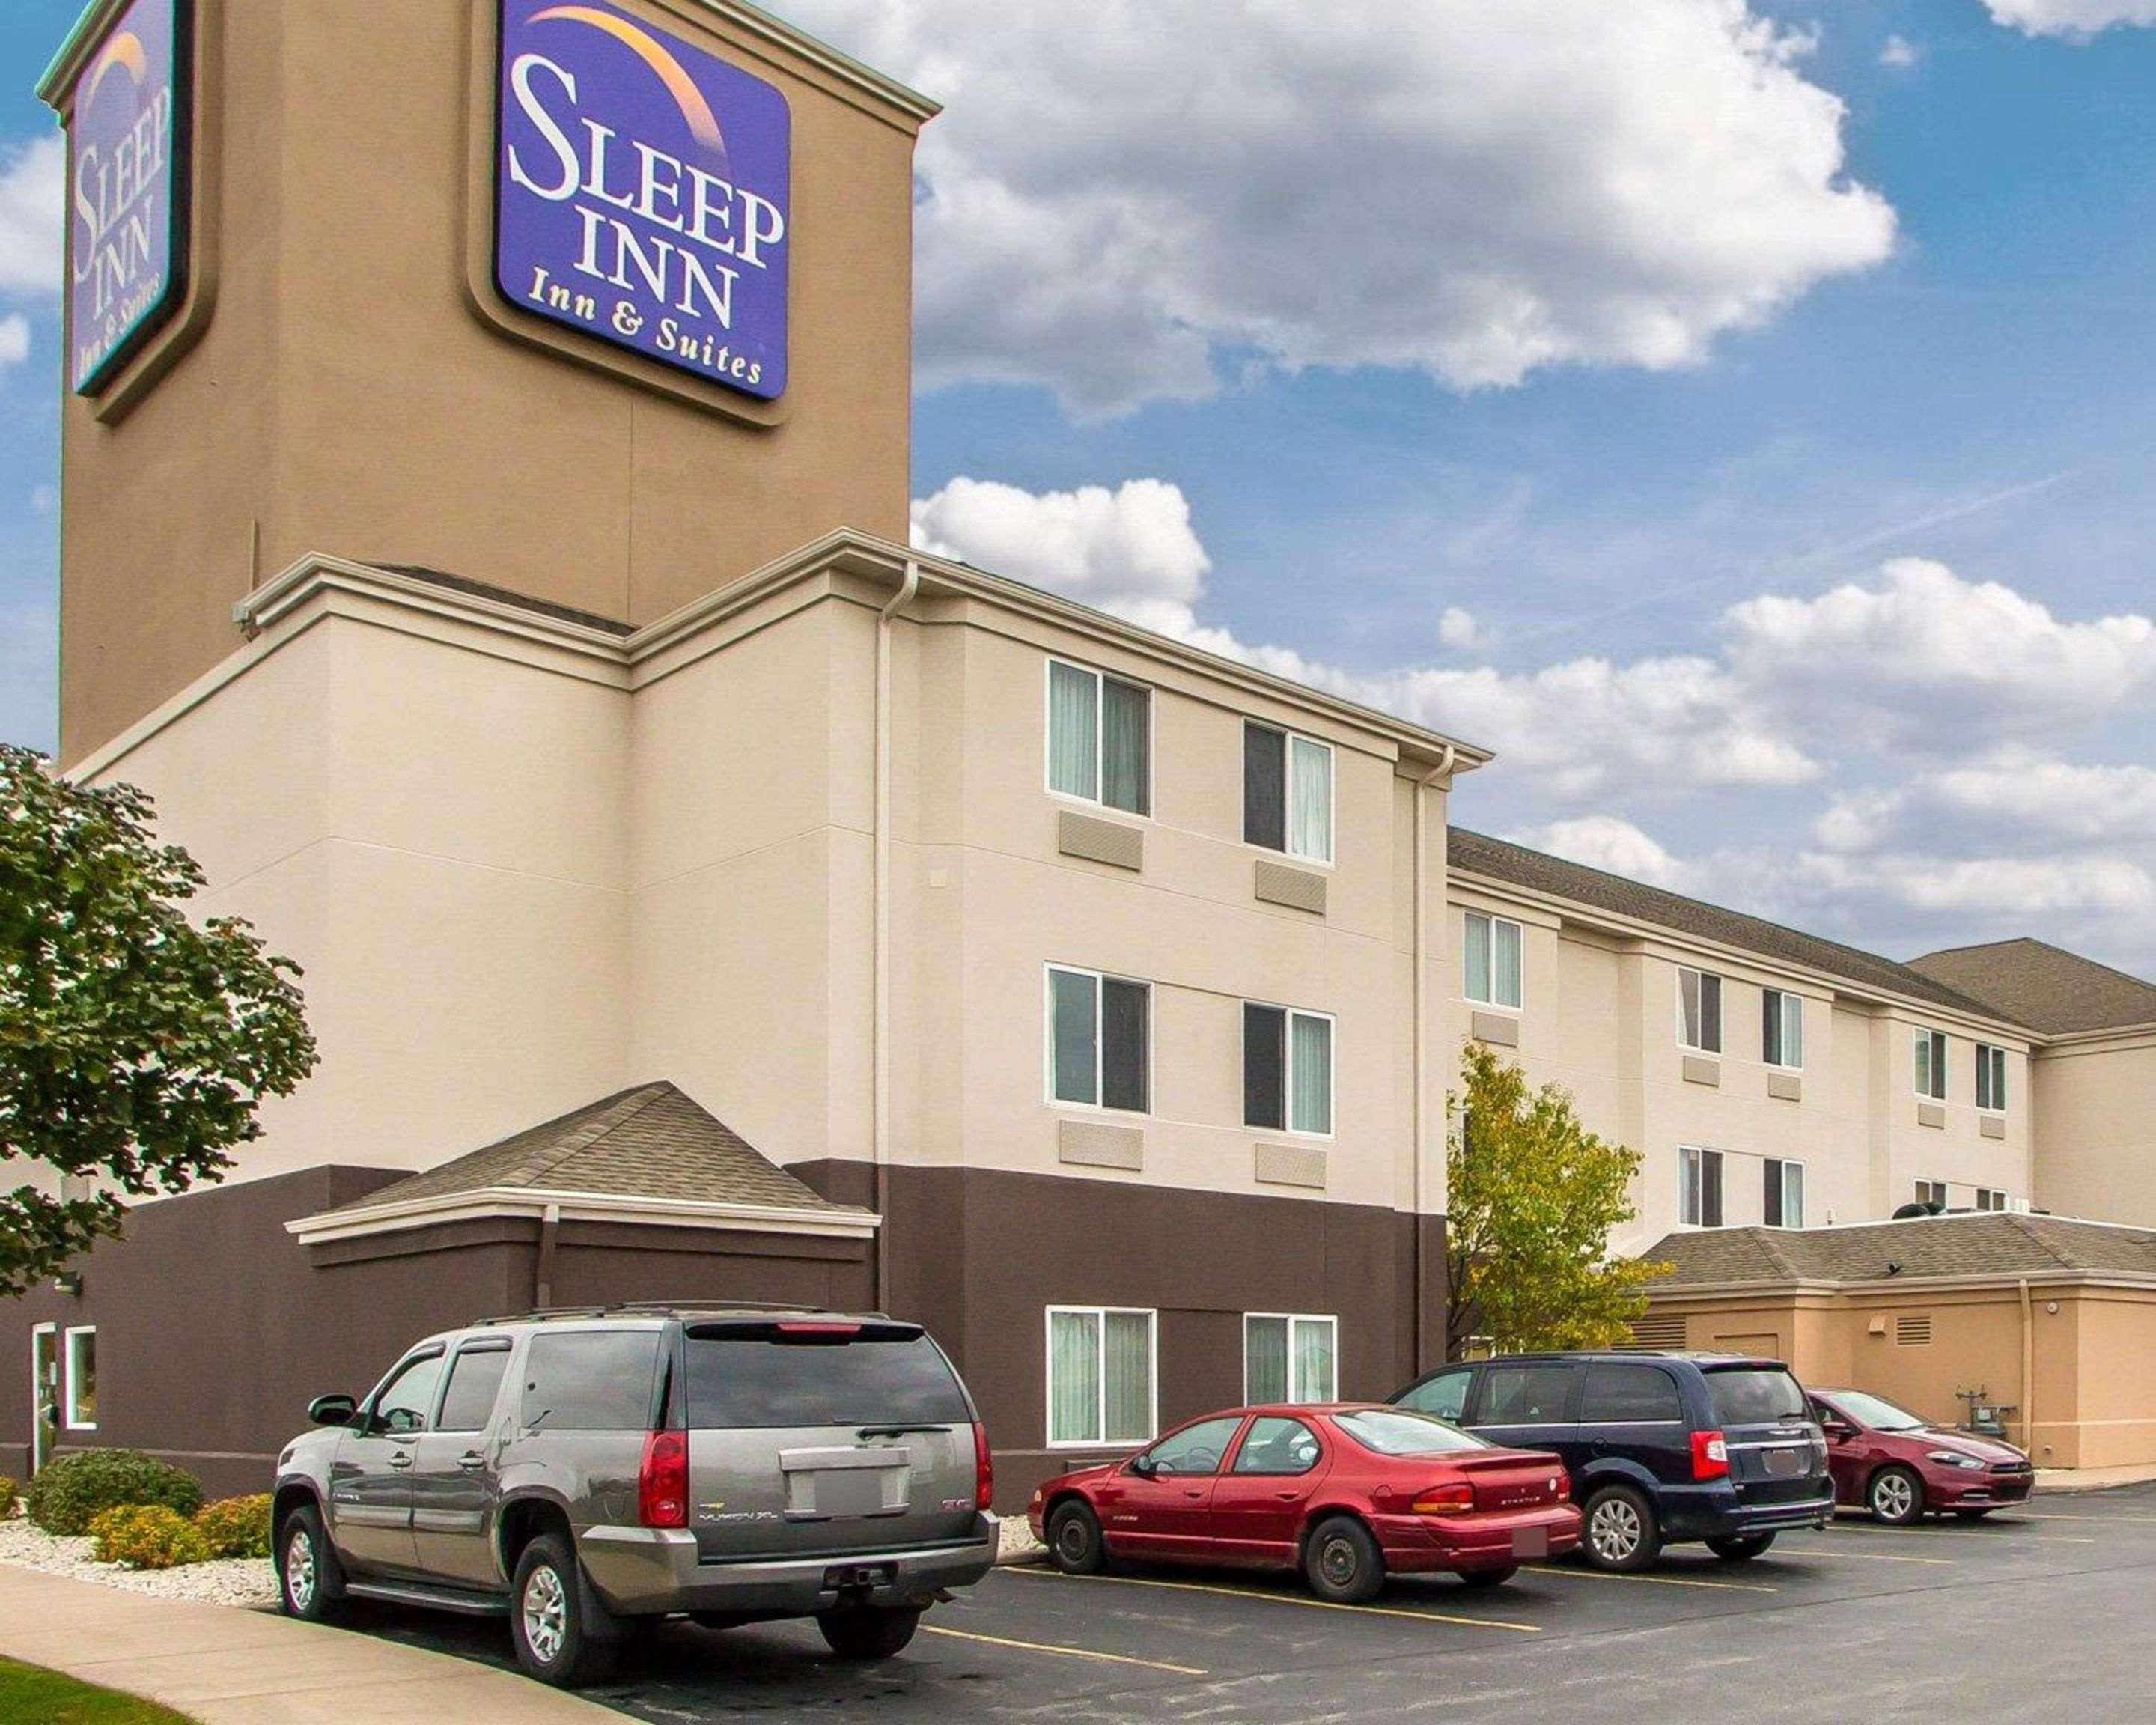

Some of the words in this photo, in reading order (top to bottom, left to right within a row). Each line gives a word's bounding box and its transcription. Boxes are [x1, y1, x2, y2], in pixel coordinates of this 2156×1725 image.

[74, 85, 171, 285] SLEEP
[508, 53, 785, 269] SLEEP
[94, 195, 155, 320] INN
[573, 204, 740, 330] INN
[529, 266, 595, 321] Inn
[612, 300, 644, 337] &
[656, 318, 761, 385] Suites
